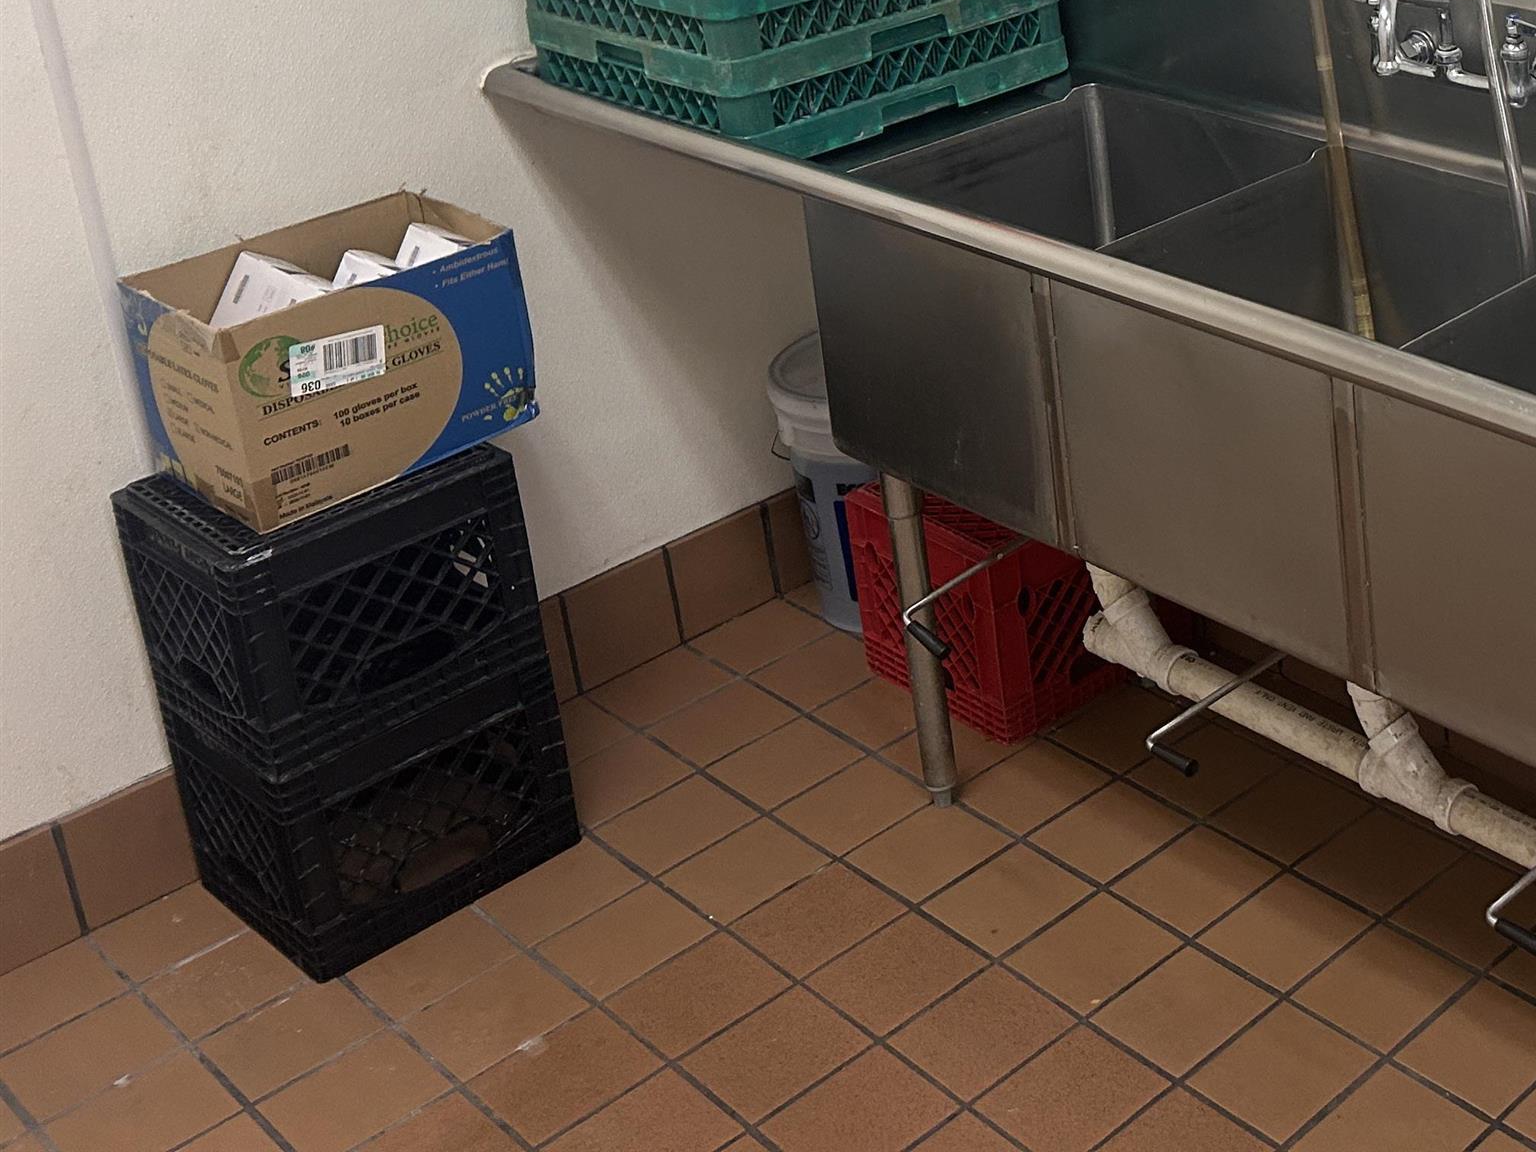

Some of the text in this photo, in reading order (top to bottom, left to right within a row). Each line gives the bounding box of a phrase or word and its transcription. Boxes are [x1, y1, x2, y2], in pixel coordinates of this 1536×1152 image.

[385, 314, 438, 343] hoice
[392, 341, 441, 366] GLOVES
[301, 379, 321, 394] 036
[333, 382, 419, 421] 100 gloves per box
[340, 391, 421, 428] 10 boxes per case
[263, 419, 322, 446] CONTENTS:
